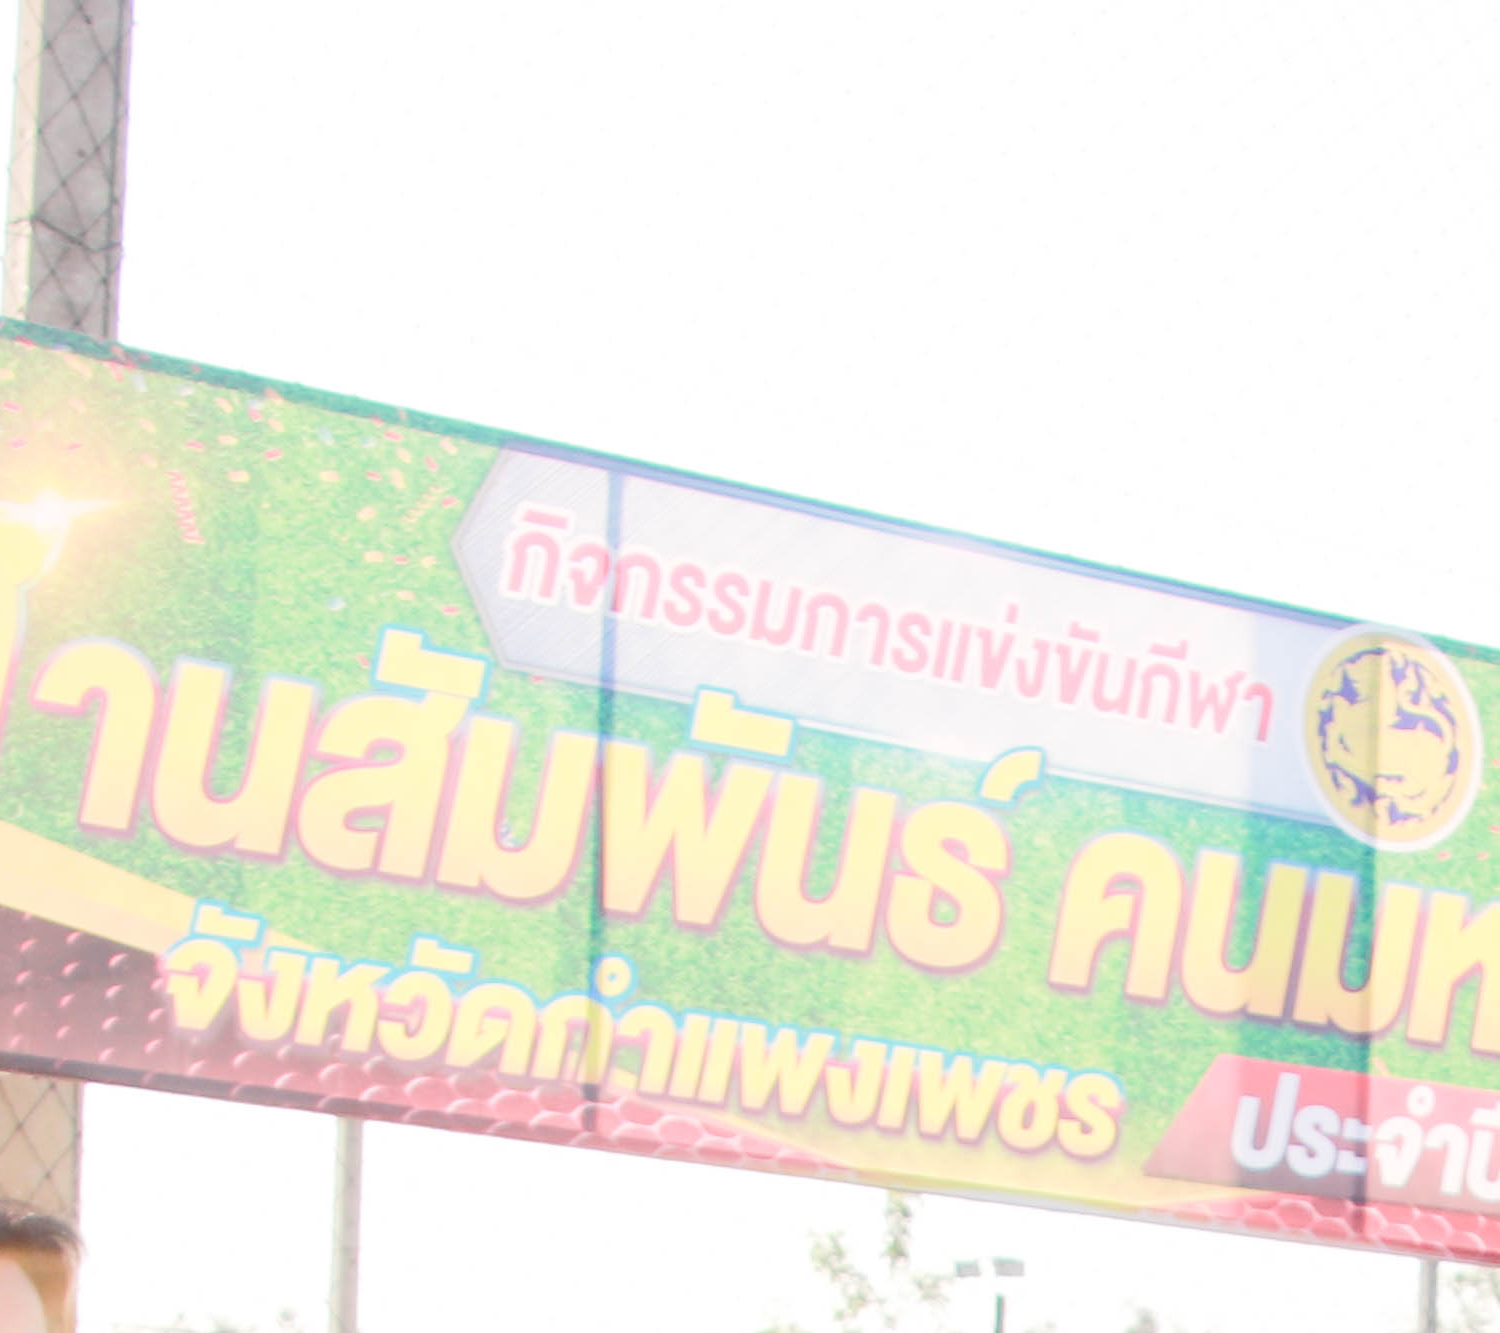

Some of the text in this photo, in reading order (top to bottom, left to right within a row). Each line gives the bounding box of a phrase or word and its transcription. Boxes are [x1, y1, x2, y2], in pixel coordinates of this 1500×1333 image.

[505, 508, 1275, 742] กิจกรรมการแข่งขันกีฬา
[160, 902, 1124, 1160] จังหวัดกำแพงเพชร
